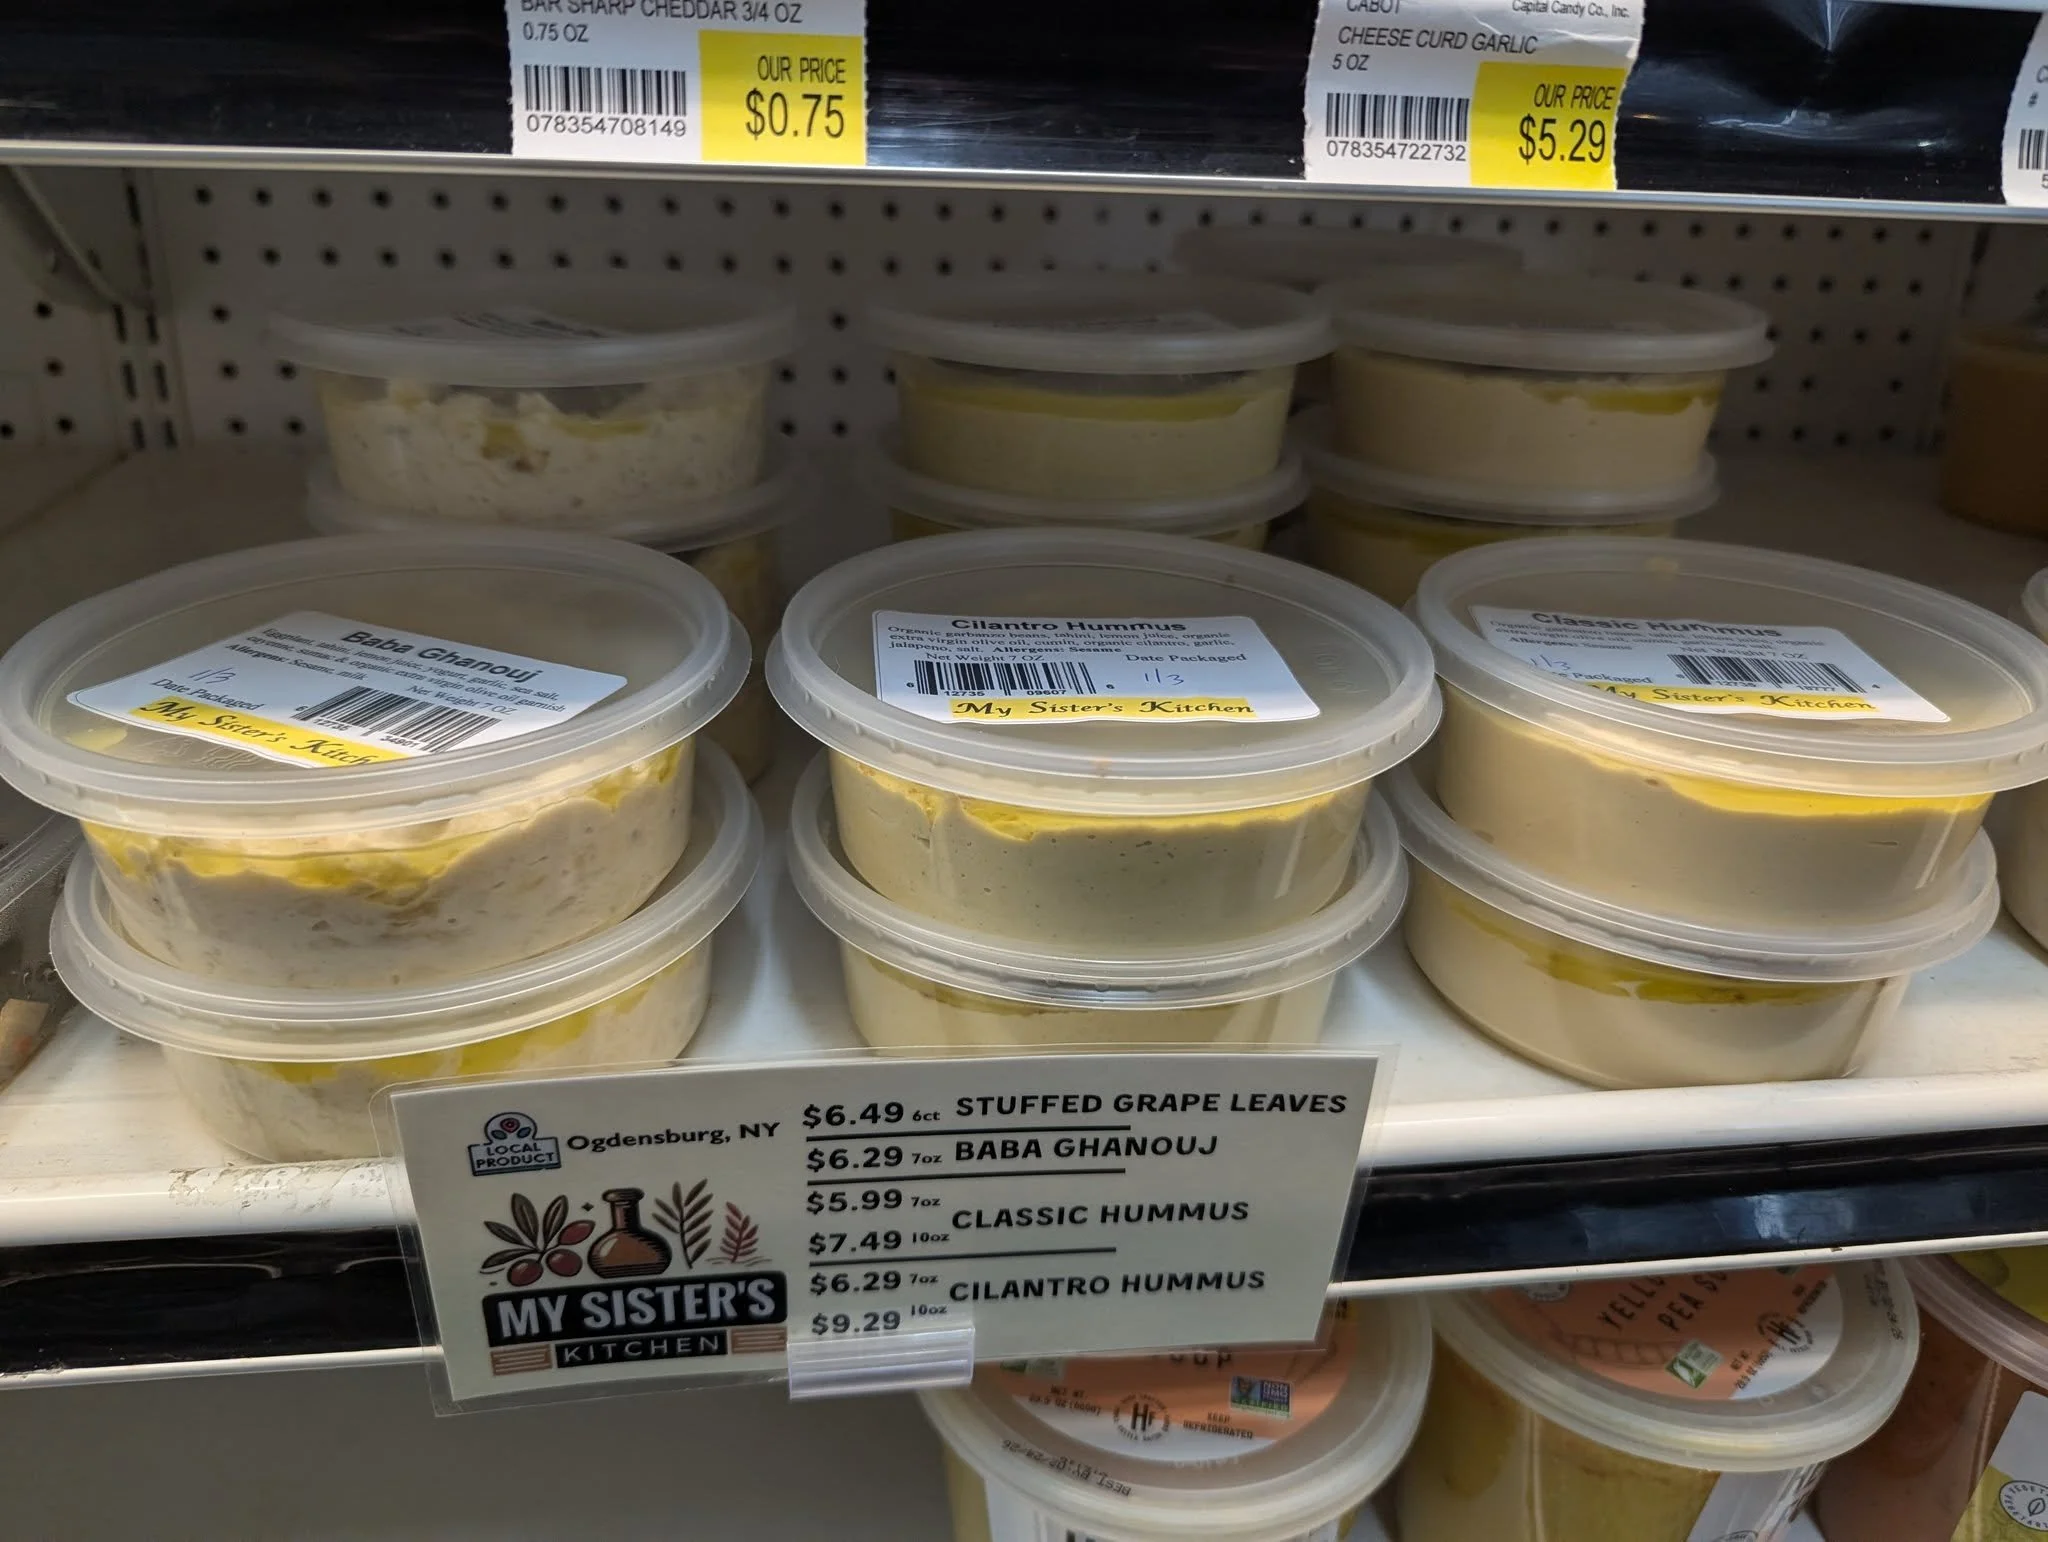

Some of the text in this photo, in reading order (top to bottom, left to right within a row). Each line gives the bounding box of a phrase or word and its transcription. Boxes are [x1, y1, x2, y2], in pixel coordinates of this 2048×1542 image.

[567, 0, 634, 16] SHARP
[641, 0, 736, 20] CHEDDAR
[741, 1, 769, 22] 3/4
[774, 3, 803, 24] OZ
[1513, 0, 1548, 14] Capital
[1552, 1, 1585, 17] Candy
[1612, 4, 1631, 18] Inc.
[522, 22, 589, 42] 0.75 OZ
[1338, 26, 1539, 54] CHEESE CURD GARLIC
[758, 55, 845, 84] OUR PRICE
[1332, 53, 1370, 71] 5 OZ
[1534, 83, 1616, 110] OUR PRICE
[527, 115, 686, 137] 078354708149
[745, 88, 845, 140] $0.75
[1327, 140, 1467, 162] 078354722732
[1519, 114, 1606, 165] $5.29
[888, 626, 1231, 641] Organic garbanzo beans, tahini, lemon juice, organic
[952, 619, 1187, 632] Cilantro Hummus
[1531, 613, 1638, 630] Classic
[1646, 620, 1783, 638] Hummus
[889, 634, 923, 642] extra
[927, 636, 968, 646] virgin
[1083, 639, 1132, 648] organic
[992, 647, 1064, 655] Allergens:
[341, 631, 544, 683] Baba Ghanouj
[926, 652, 951, 661] Net
[955, 654, 1005, 663] Weight
[1126, 653, 1247, 664] Date Packaged
[511, 685, 533, 695] sea
[1573, 672, 1653, 685] Packaged
[152, 678, 265, 710] Date Packaged
[406, 685, 433, 696] Net
[434, 690, 479, 707] Weight
[491, 704, 518, 716] OZ
[1026, 689, 1067, 697] 09607
[1652, 688, 1745, 703] Sister's
[1759, 694, 1876, 710] Kitchen
[953, 700, 1255, 717] My Sister's Kitchen
[138, 700, 379, 765] My Sister's Kitch
[802, 1092, 1348, 1129] $6.49 6ct STUFFED GRAPE LEAVES
[486, 1141, 541, 1156] LOCAL
[567, 1122, 781, 1153] Ogdensburg, NY
[476, 1152, 555, 1169] PRODUCT
[806, 1135, 1219, 1173] $6.29 7oz BABA GHANOUJ
[806, 1188, 941, 1215] $5.99 7oz
[951, 1201, 1250, 1230] CLASSIC HUMMUS
[809, 1230, 950, 1255] $7.49 10oz
[809, 1270, 939, 1296] $6.29 7oz
[949, 1271, 1266, 1302] CILANTRO HUMMUS
[499, 1278, 776, 1338] MY SISTER'S
[1597, 1276, 1665, 1331] YELLO
[1657, 1291, 1705, 1332] PEA
[811, 1304, 947, 1335] $9.29 10oz
[564, 1335, 719, 1362] KITCHEN
